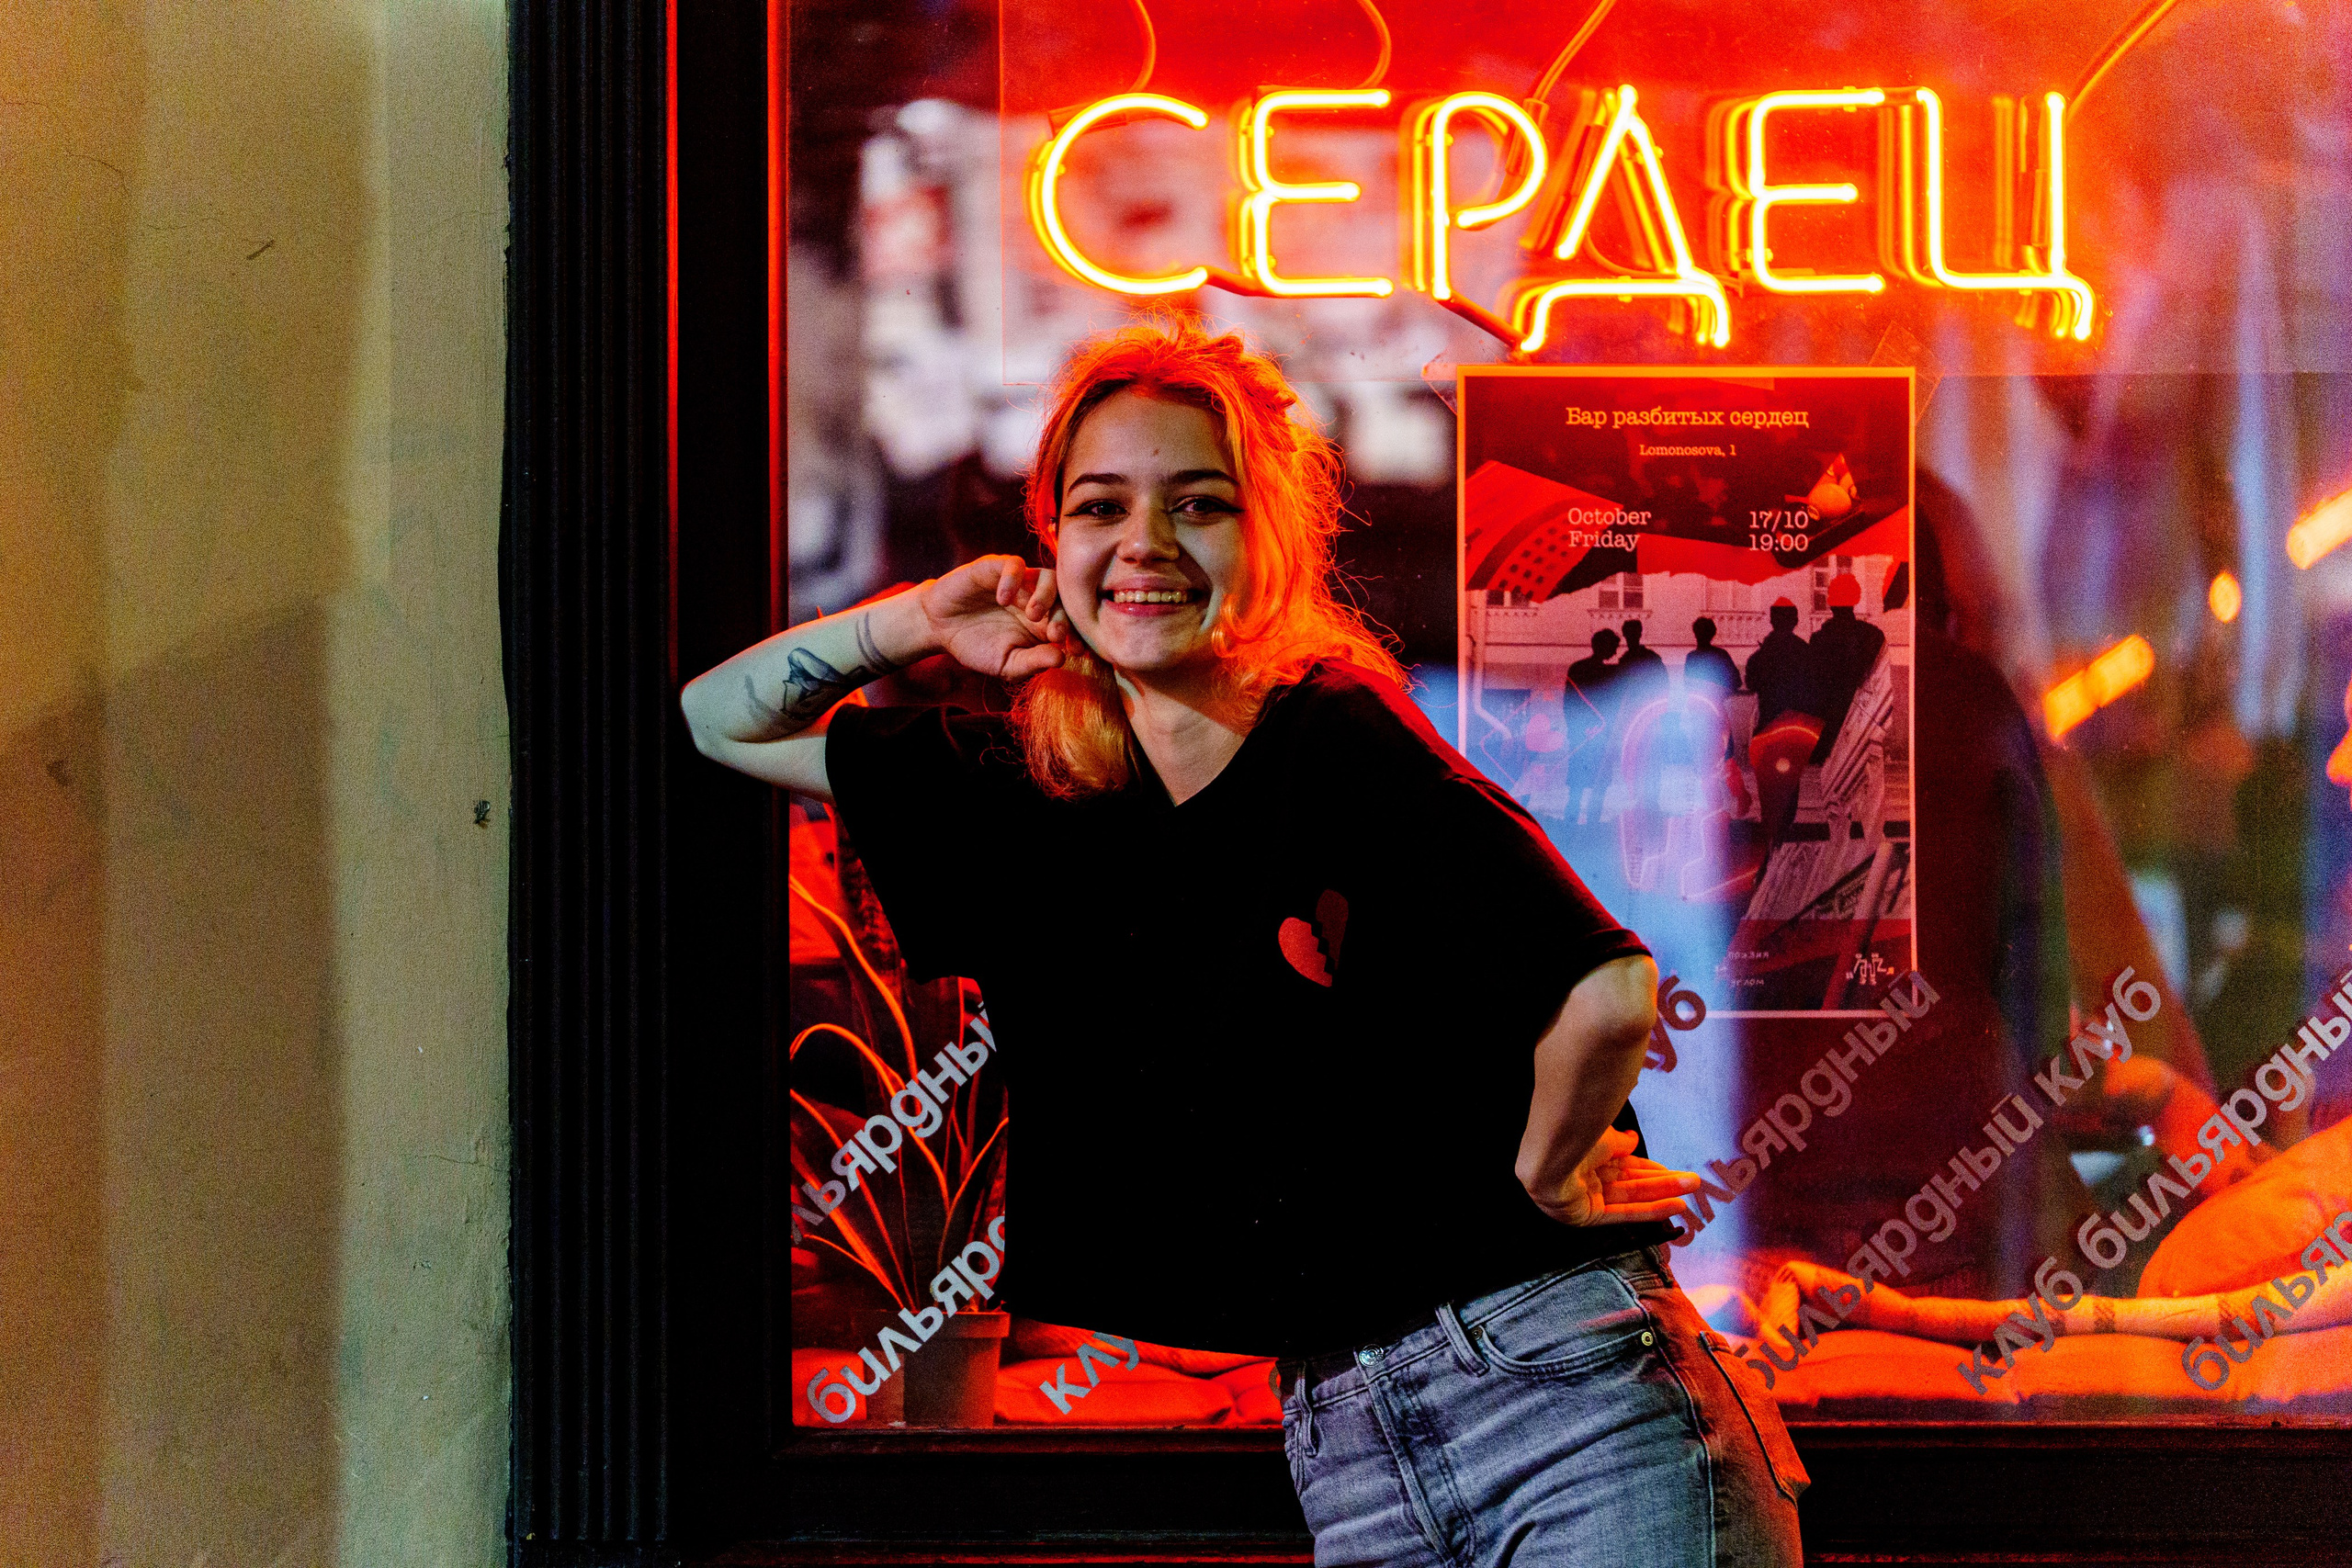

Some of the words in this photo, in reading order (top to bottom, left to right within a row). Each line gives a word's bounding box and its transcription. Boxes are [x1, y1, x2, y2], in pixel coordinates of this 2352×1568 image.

[1031, 85, 2094, 353] СЕРДЕЦ
[1566, 407, 1607, 429] Бар
[1612, 405, 1725, 429] разбитых
[1729, 411, 1809, 429] сердец
[1639, 445, 1725, 457] Lomonosova,
[1729, 445, 1736, 456] 1
[1567, 507, 1651, 526] October
[1749, 510, 1809, 533] 17/10
[1567, 530, 1641, 552] Friday
[1749, 534, 1809, 552] 19:00
[2033, 965, 2162, 1105] клуб
[791, 1000, 997, 1245] льярдны
[1657, 968, 1941, 1270] ильярдный
[1956, 1256, 2083, 1395] клуб
[2077, 969, 2352, 1269] бильярдны
